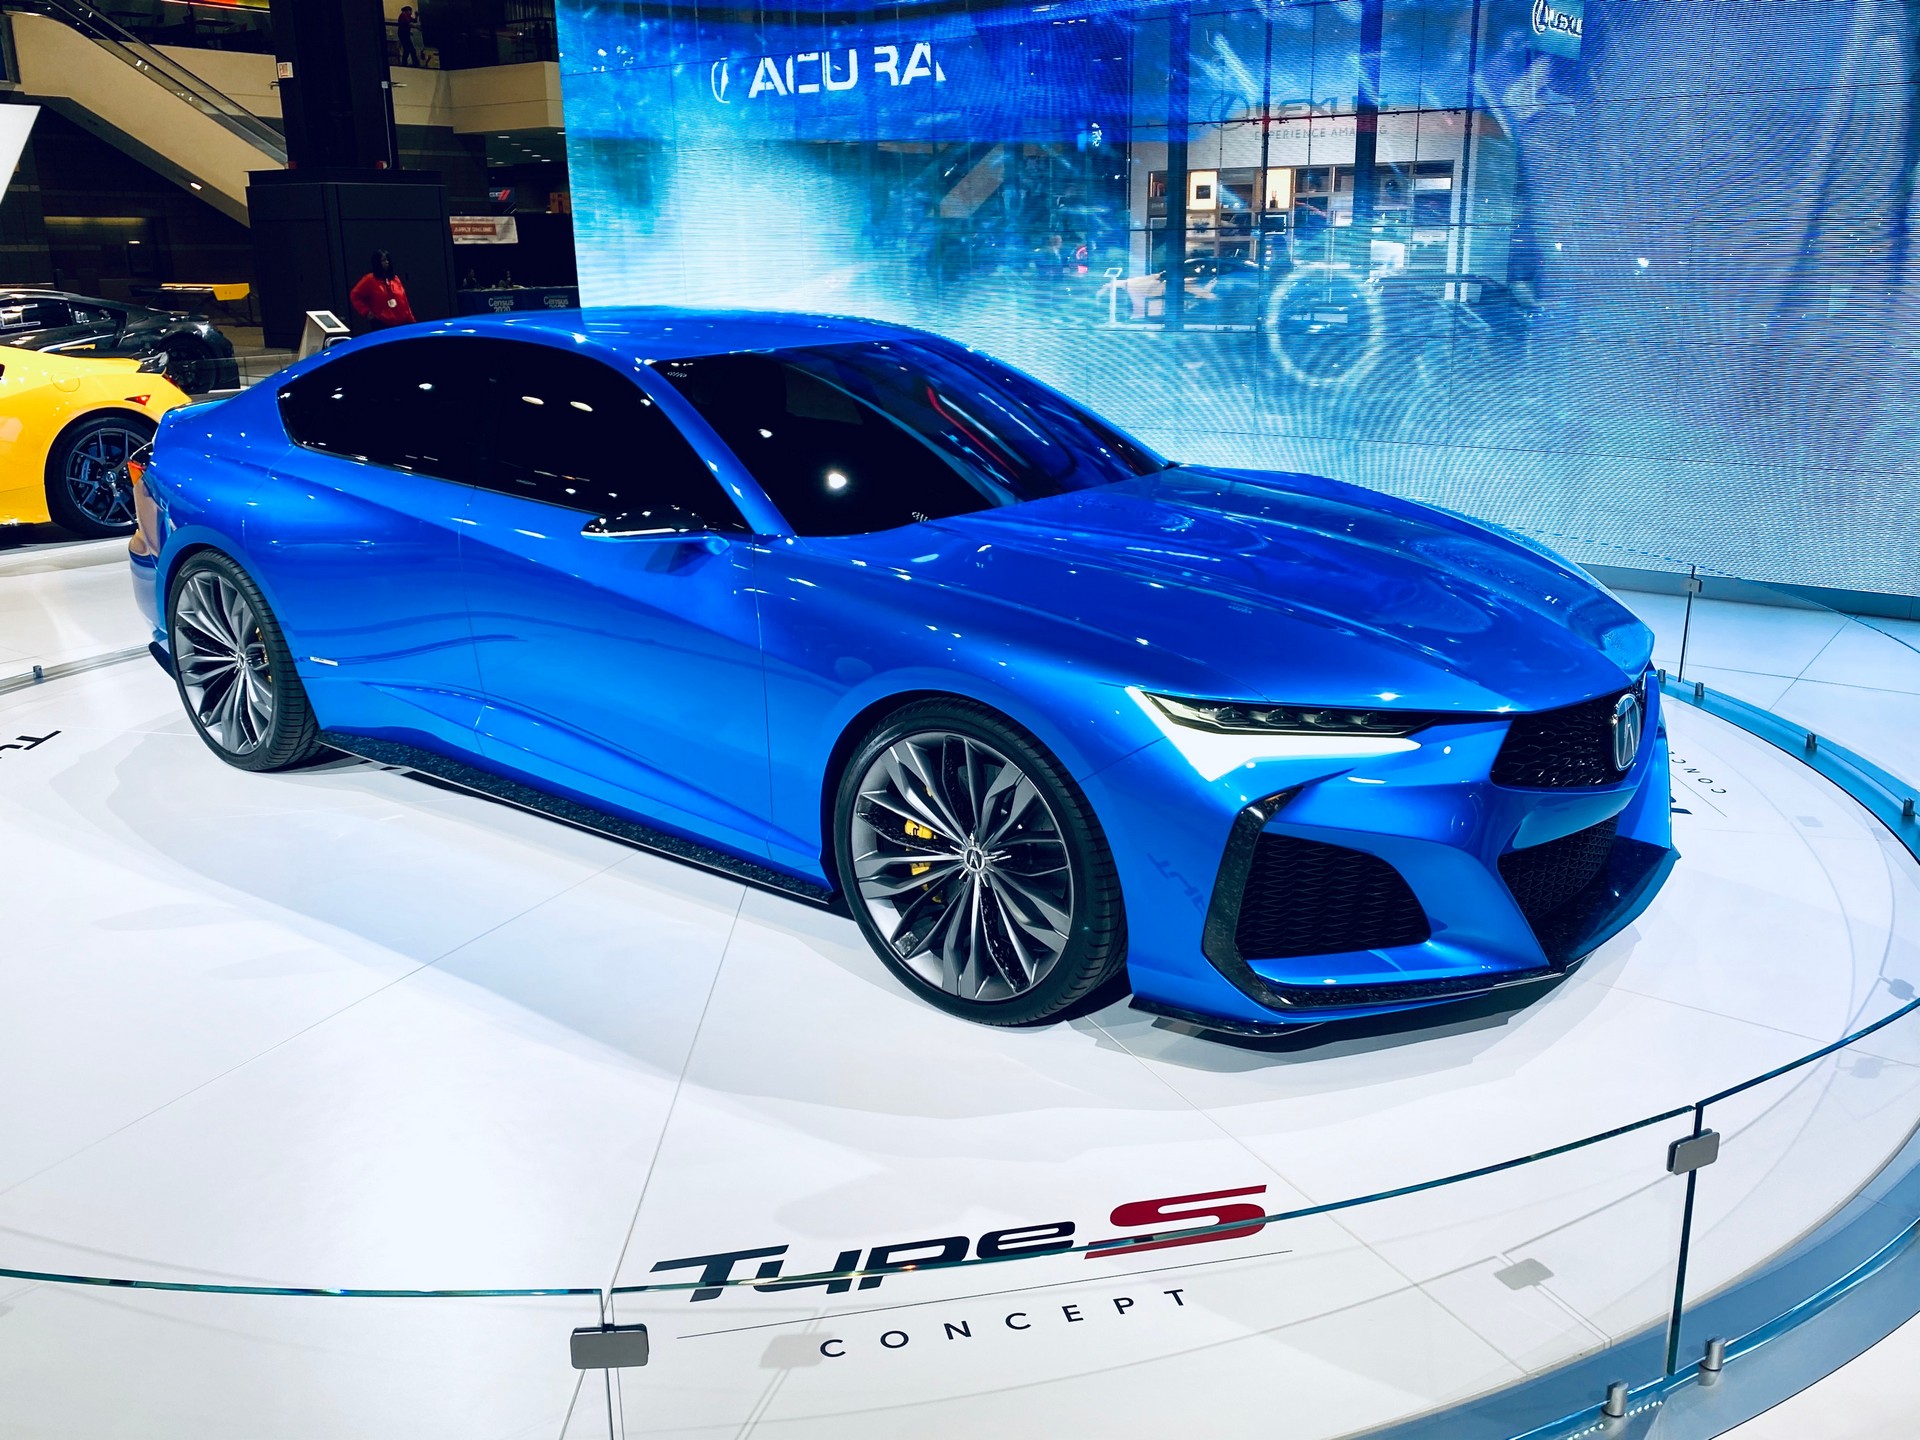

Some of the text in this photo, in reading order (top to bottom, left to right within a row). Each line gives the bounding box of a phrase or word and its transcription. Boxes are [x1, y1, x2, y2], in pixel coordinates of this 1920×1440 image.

[748, 42, 947, 98] ACURA
[1254, 125, 1388, 140] EPERIENCE AMAG
[489, 298, 514, 307] Census
[544, 296, 569, 305] Census
[1669, 751, 1727, 794] CONC
[1083, 1184, 1268, 1260] S
[819, 1288, 1187, 1359] CONCEPT
